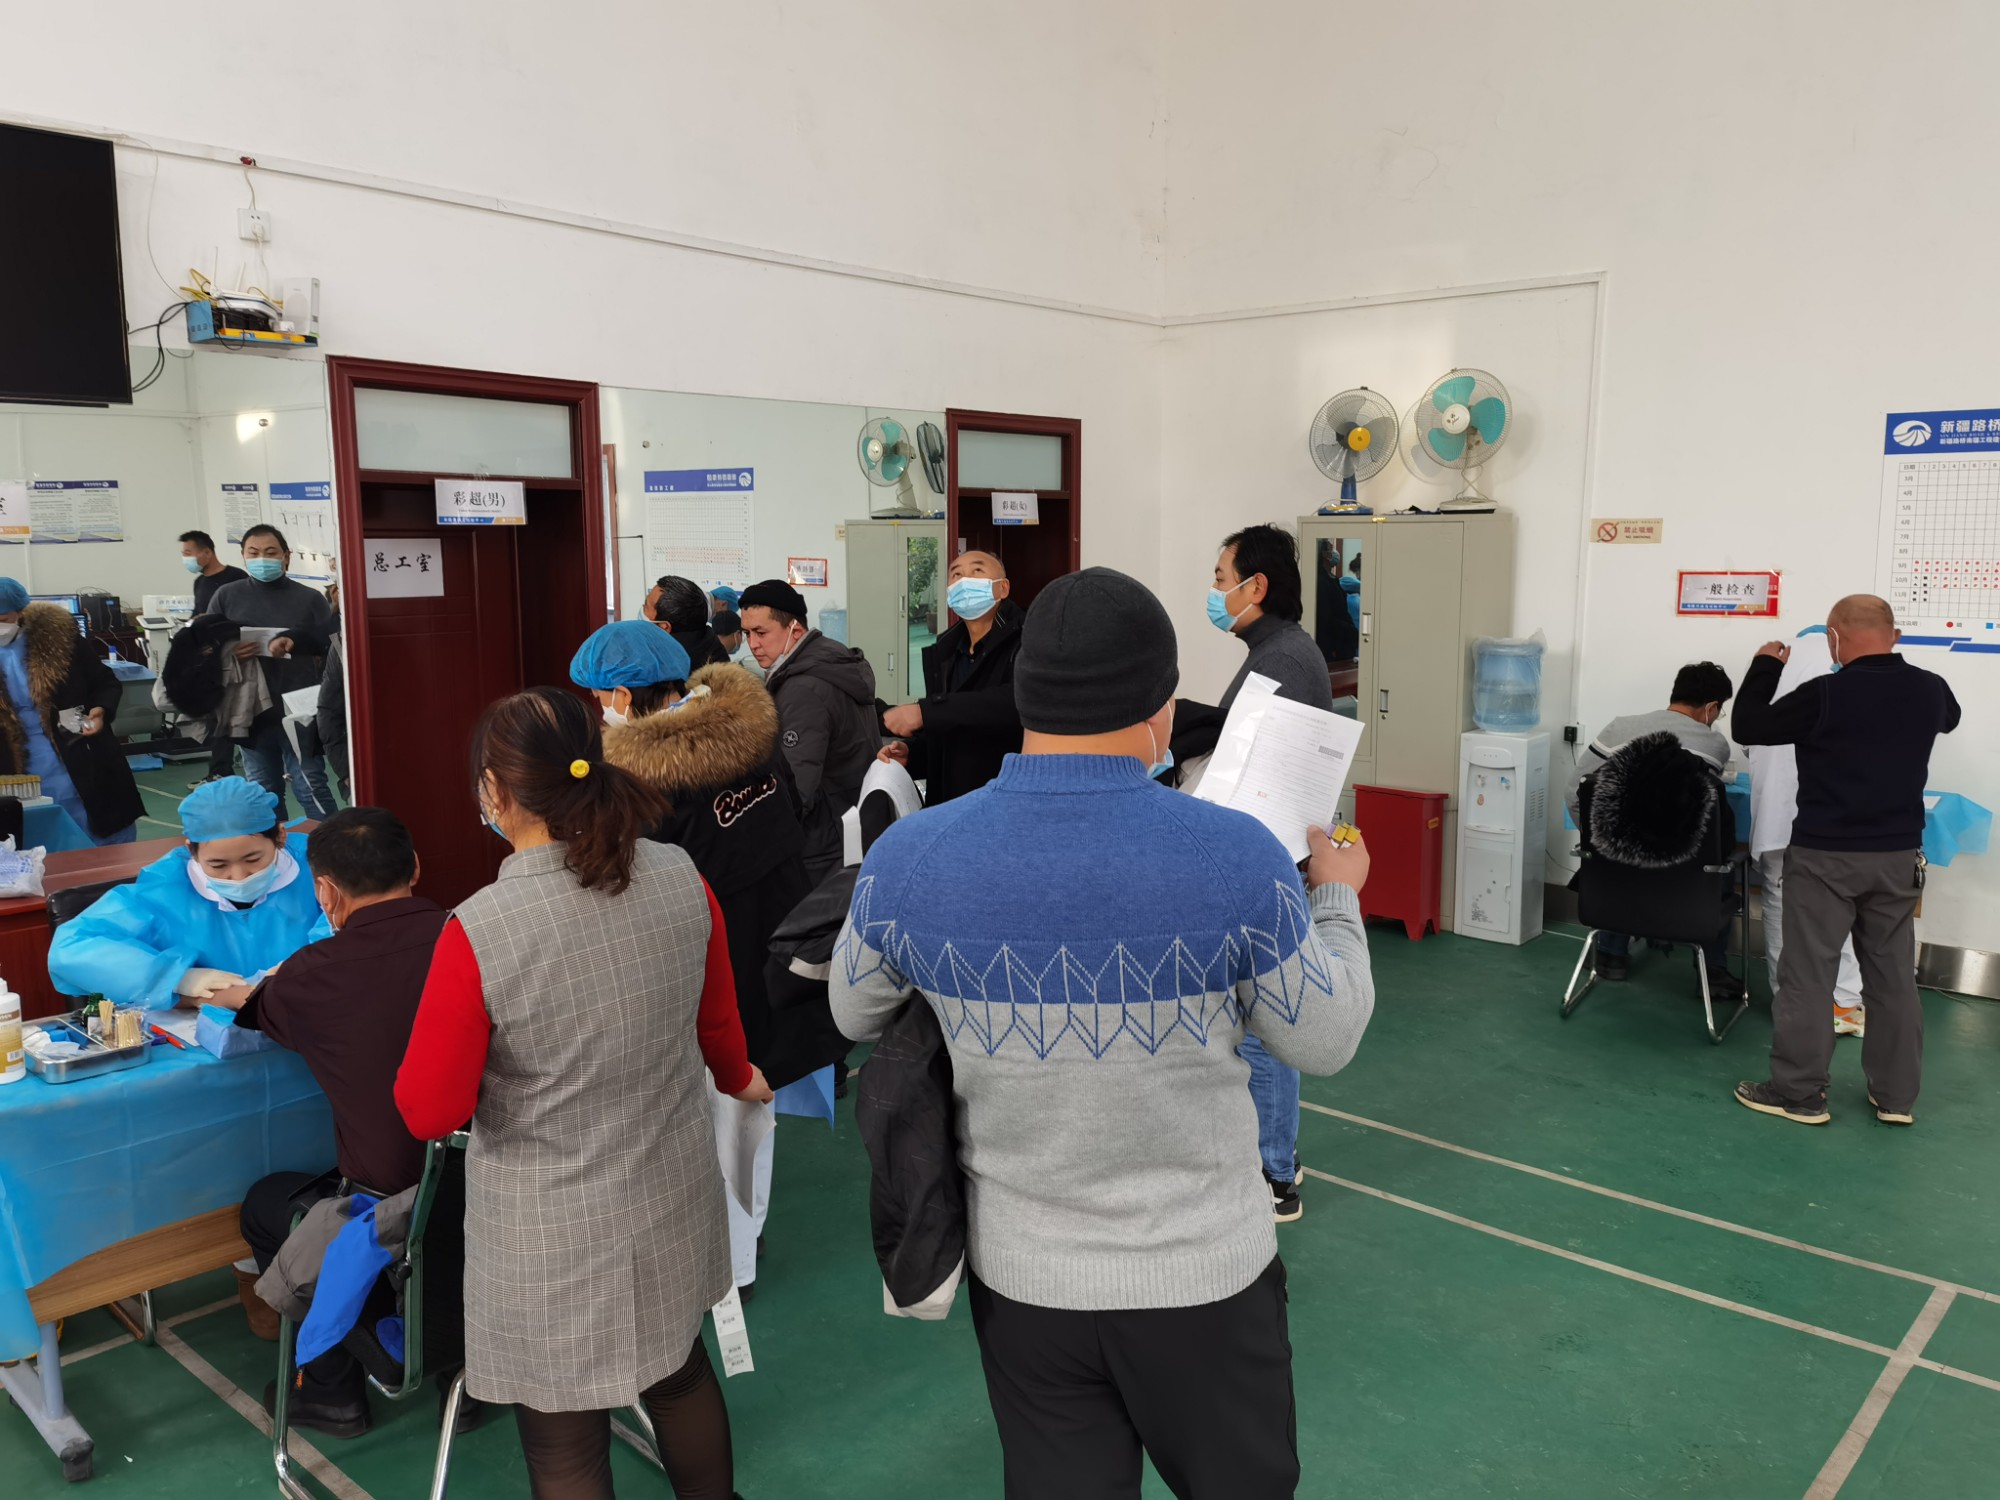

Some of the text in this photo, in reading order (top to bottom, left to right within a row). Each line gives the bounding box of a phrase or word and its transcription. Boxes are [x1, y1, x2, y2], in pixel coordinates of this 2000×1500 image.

[1940, 418, 2000, 433] 新疆路桥
[453, 490, 506, 508] 彩超(男)
[1624, 526, 1654, 534] 禁止吸烟
[373, 551, 432, 573] 总工室
[1694, 583, 1756, 596] 一般检查
